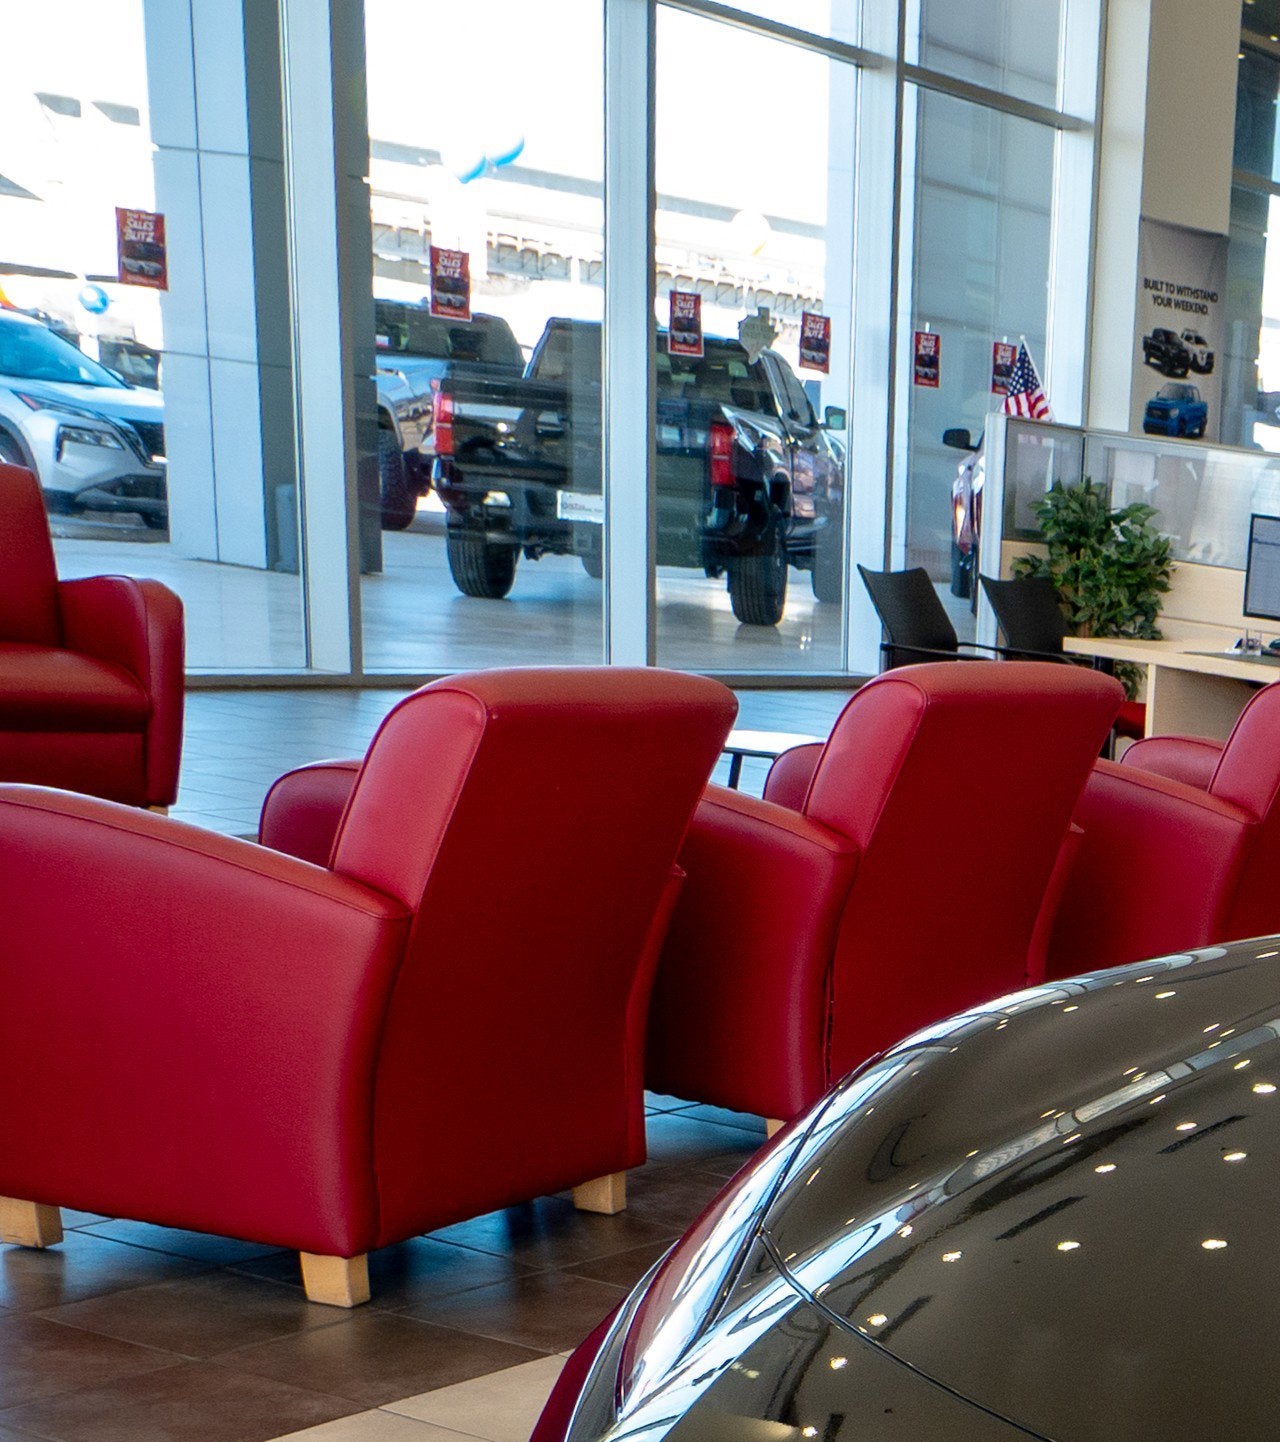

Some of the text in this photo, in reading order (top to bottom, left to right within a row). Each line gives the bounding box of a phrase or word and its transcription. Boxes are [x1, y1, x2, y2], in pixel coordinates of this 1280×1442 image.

[1143, 277, 1219, 303] BUILT TO WITHSTAND
[1152, 294, 1172, 308] YOUR
